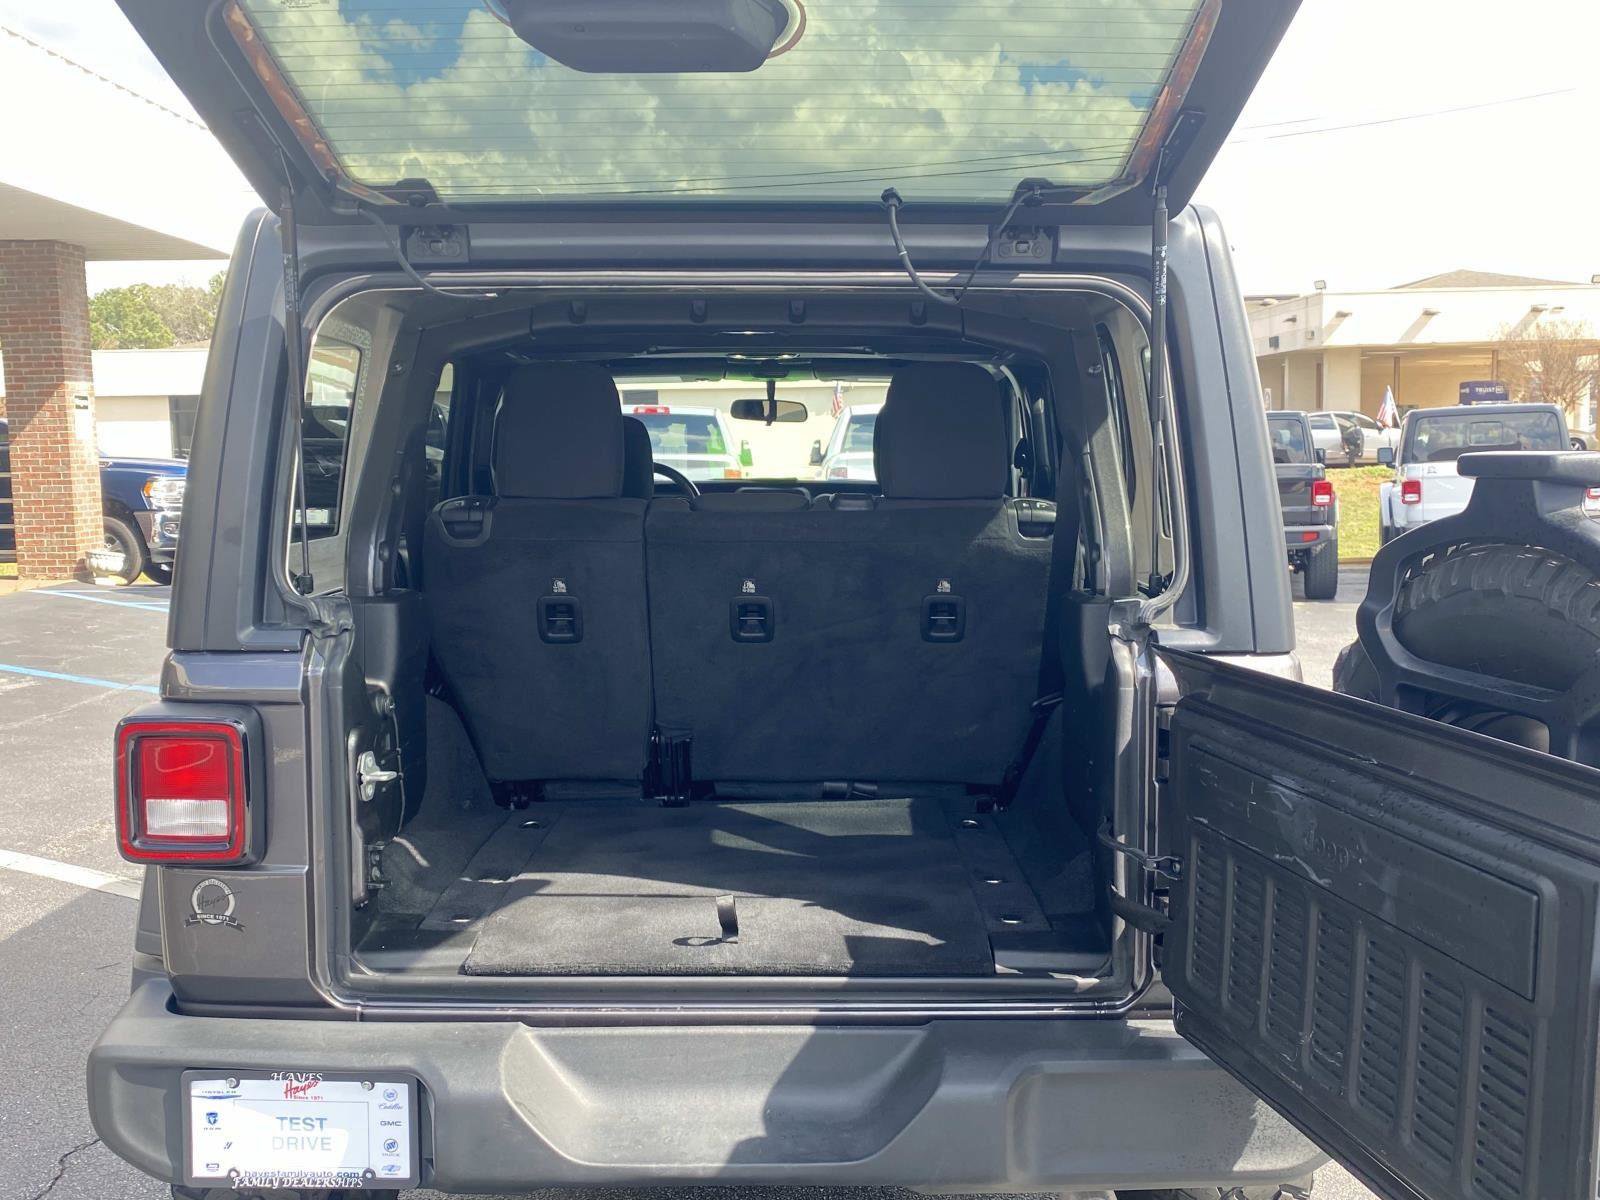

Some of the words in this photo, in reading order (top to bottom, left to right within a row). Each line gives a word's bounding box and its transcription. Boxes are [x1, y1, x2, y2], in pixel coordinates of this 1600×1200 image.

[1303, 824, 1350, 870] Jeep
[270, 1071, 323, 1083] HAYES
[284, 1079, 320, 1100] Hayes
[275, 1116, 328, 1132] TEST
[272, 1136, 332, 1152] DRIVE
[231, 1176, 280, 1190] FAMILY
[281, 1176, 363, 1188] DEALERSHIPS
